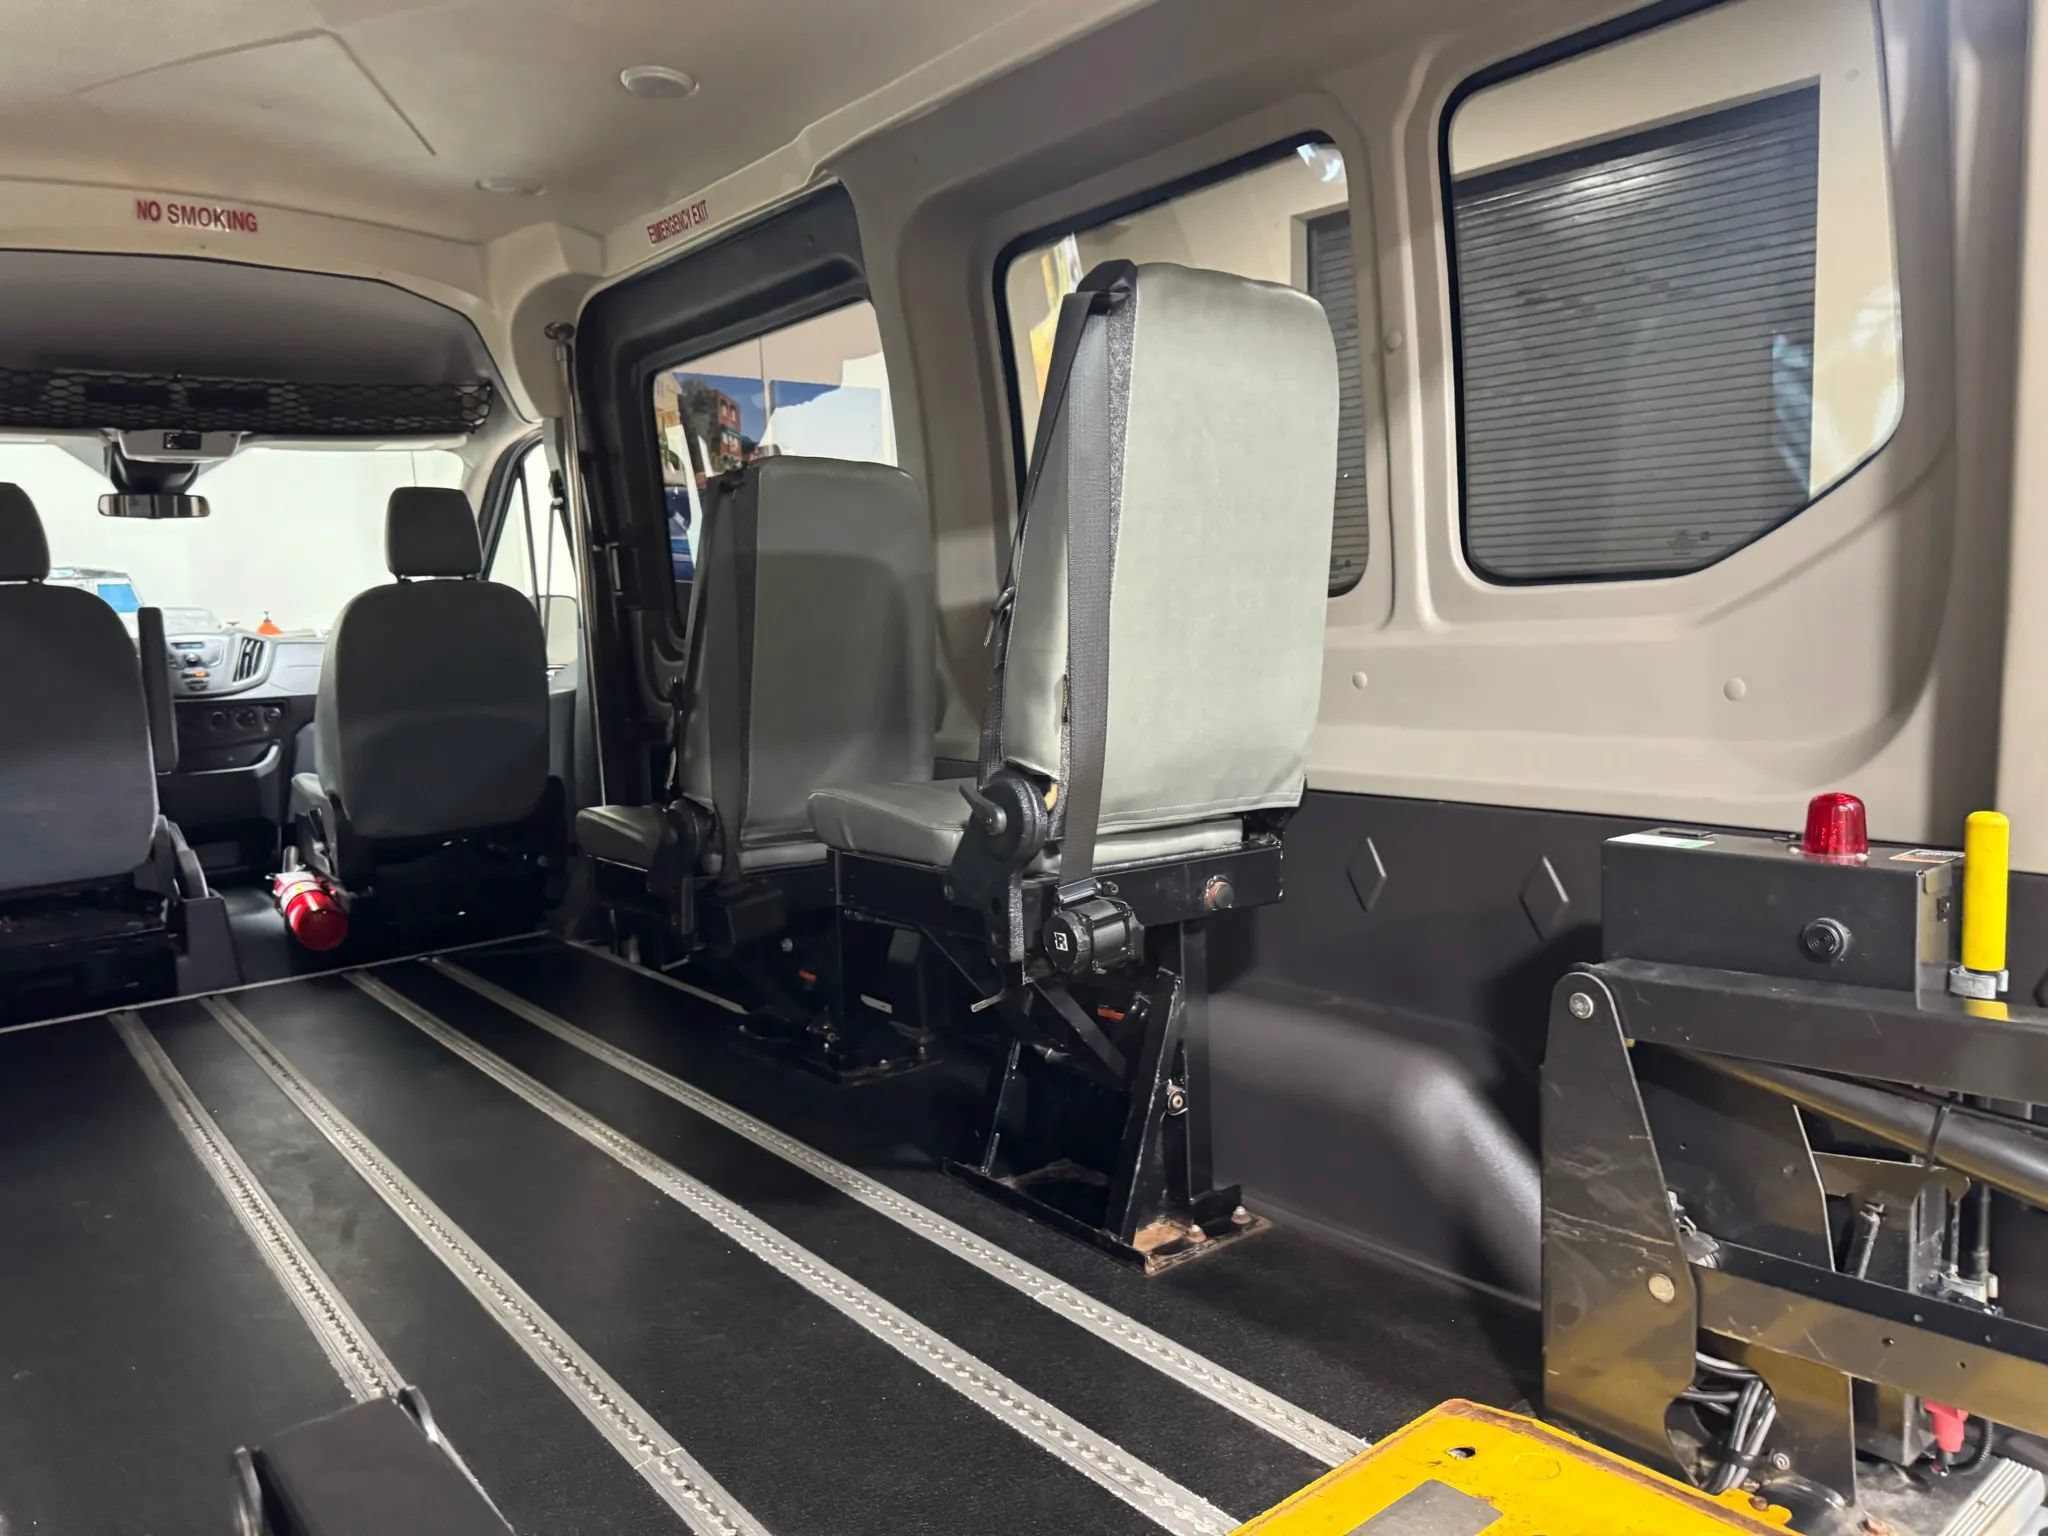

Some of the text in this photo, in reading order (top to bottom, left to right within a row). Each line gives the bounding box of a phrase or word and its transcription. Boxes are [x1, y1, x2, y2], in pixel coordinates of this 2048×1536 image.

[136, 199, 258, 232] NO SMOKING
[647, 199, 709, 243] EMERGENCY EXIT
